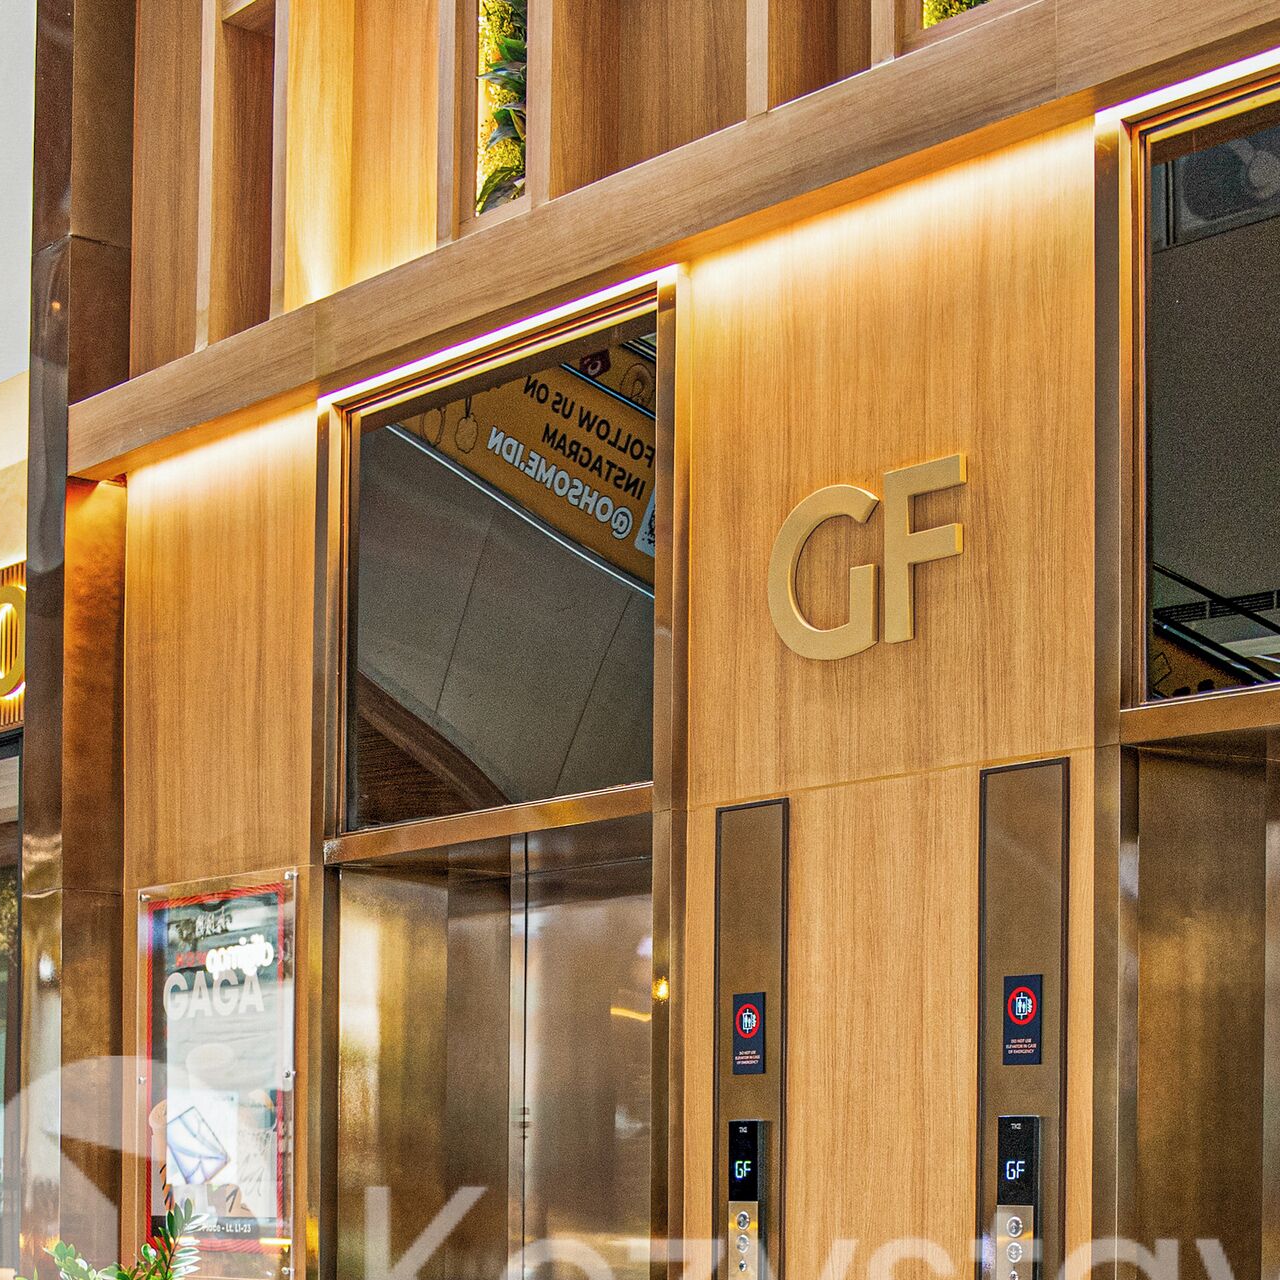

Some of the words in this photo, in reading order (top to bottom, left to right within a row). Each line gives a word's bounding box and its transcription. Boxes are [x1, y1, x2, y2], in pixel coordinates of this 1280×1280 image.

[768, 453, 967, 660] GF
[163, 969, 264, 1020] GAGA
[735, 1160, 752, 1179] GF
[1006, 1160, 1025, 1180] GF
